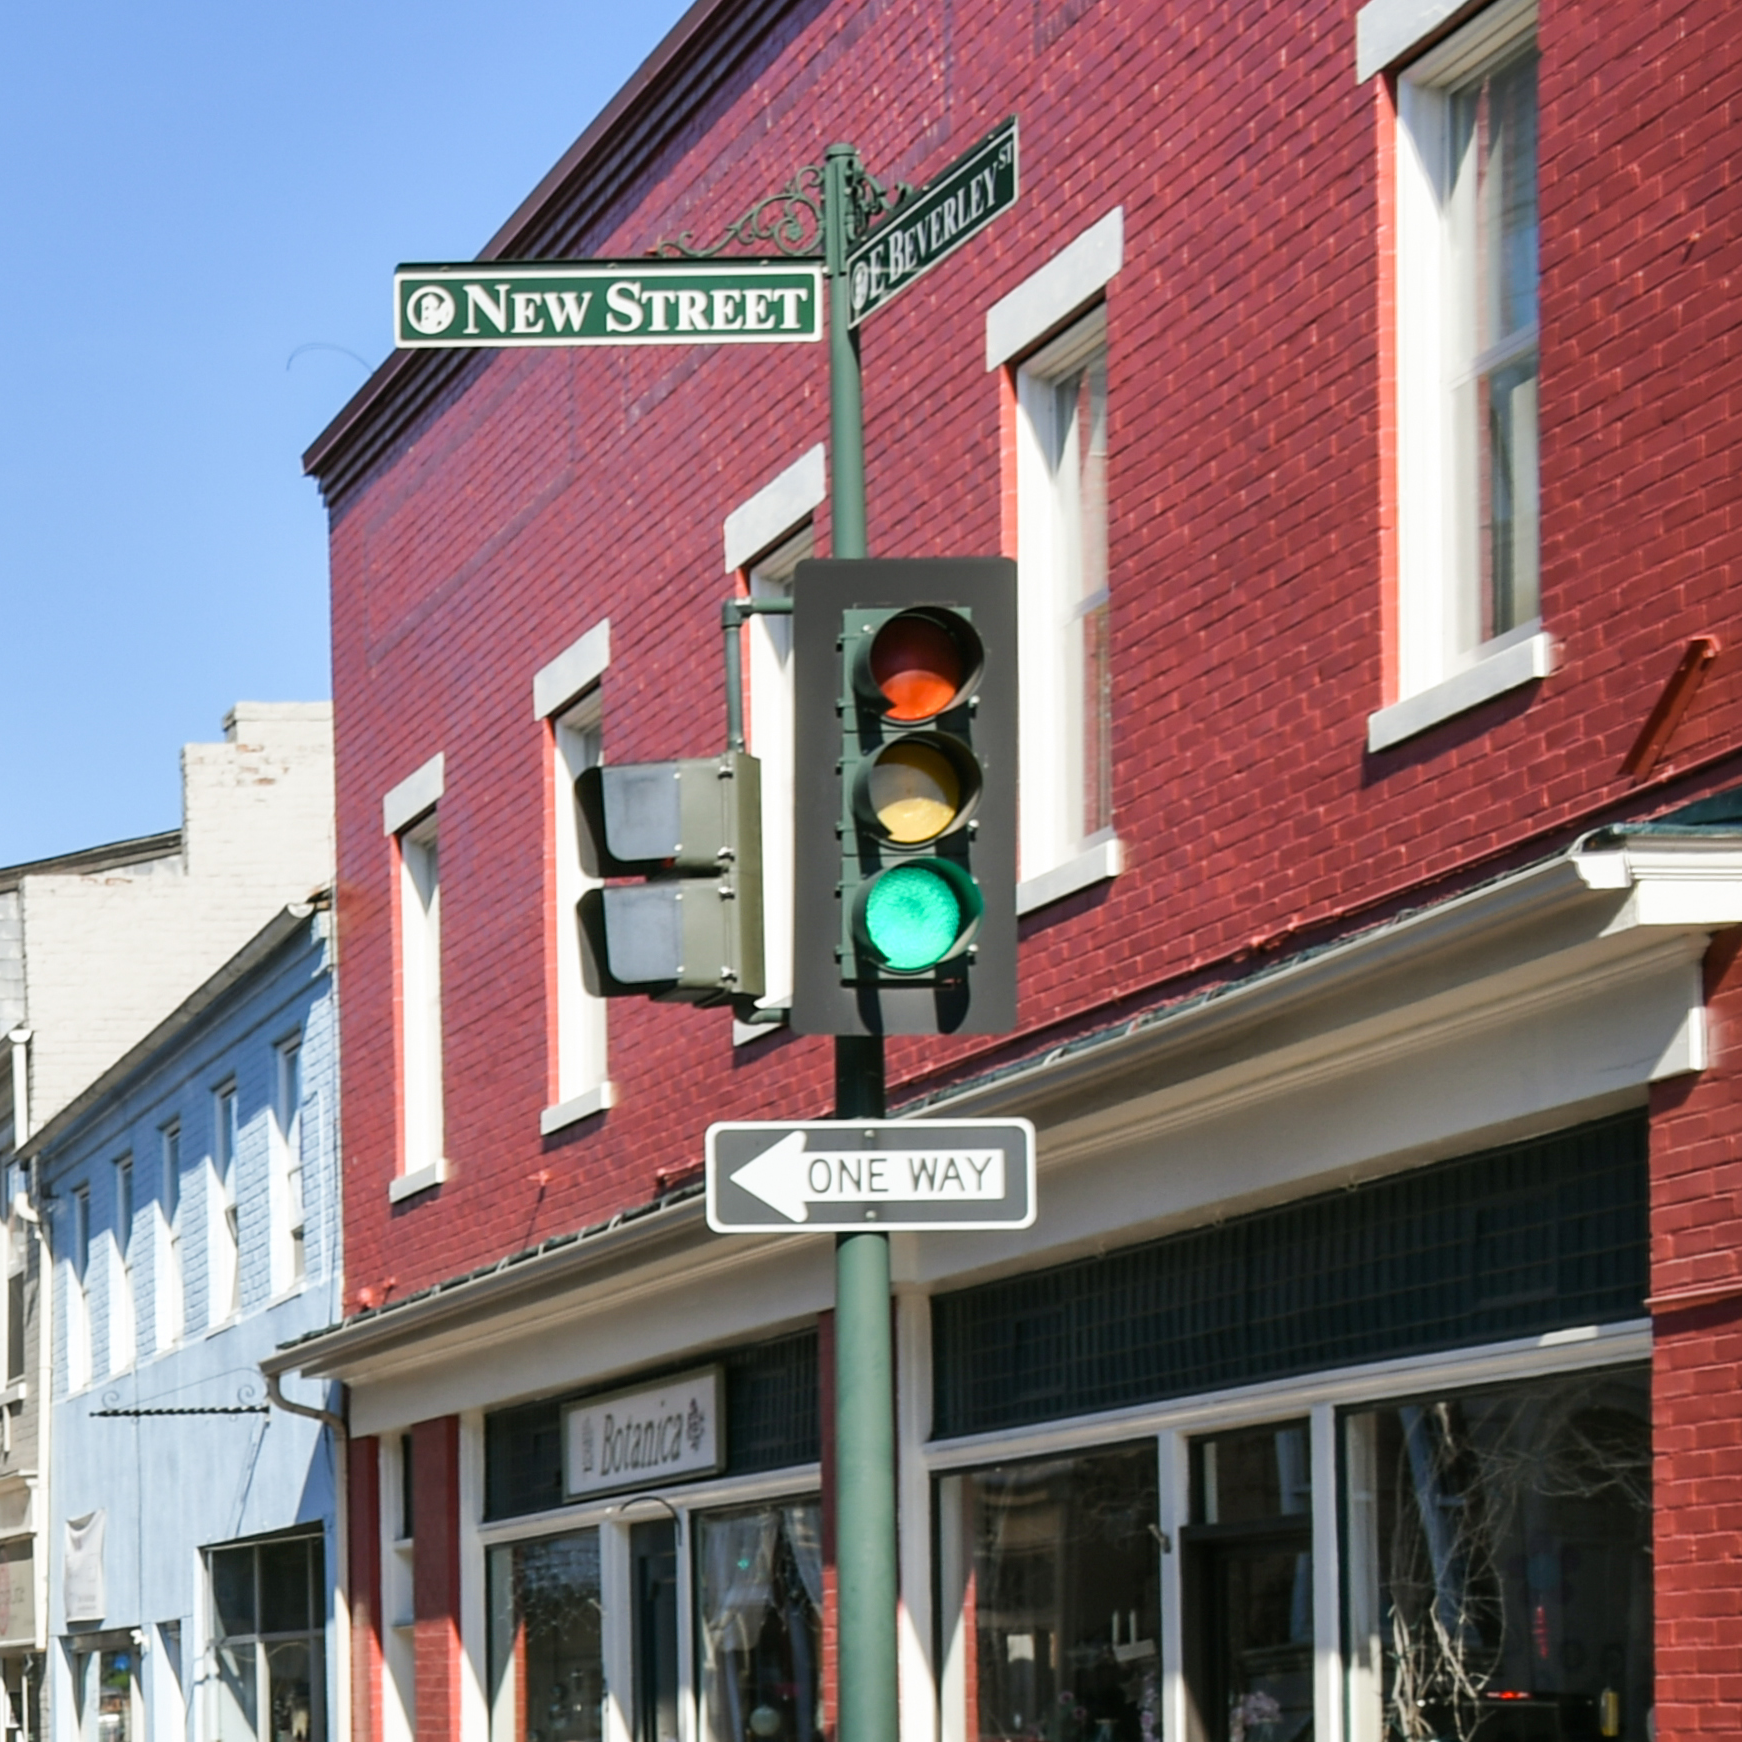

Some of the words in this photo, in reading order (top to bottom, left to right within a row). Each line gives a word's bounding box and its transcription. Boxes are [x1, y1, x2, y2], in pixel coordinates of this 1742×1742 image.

[869, 243, 885, 299] E
[888, 162, 998, 285] BEVERLEY
[998, 140, 1013, 170] ST
[462, 283, 593, 335] NEW
[605, 280, 808, 333] STREET
[808, 1158, 889, 1194] ONE
[907, 1156, 993, 1192] WAY
[600, 1400, 683, 1477] Botanica
